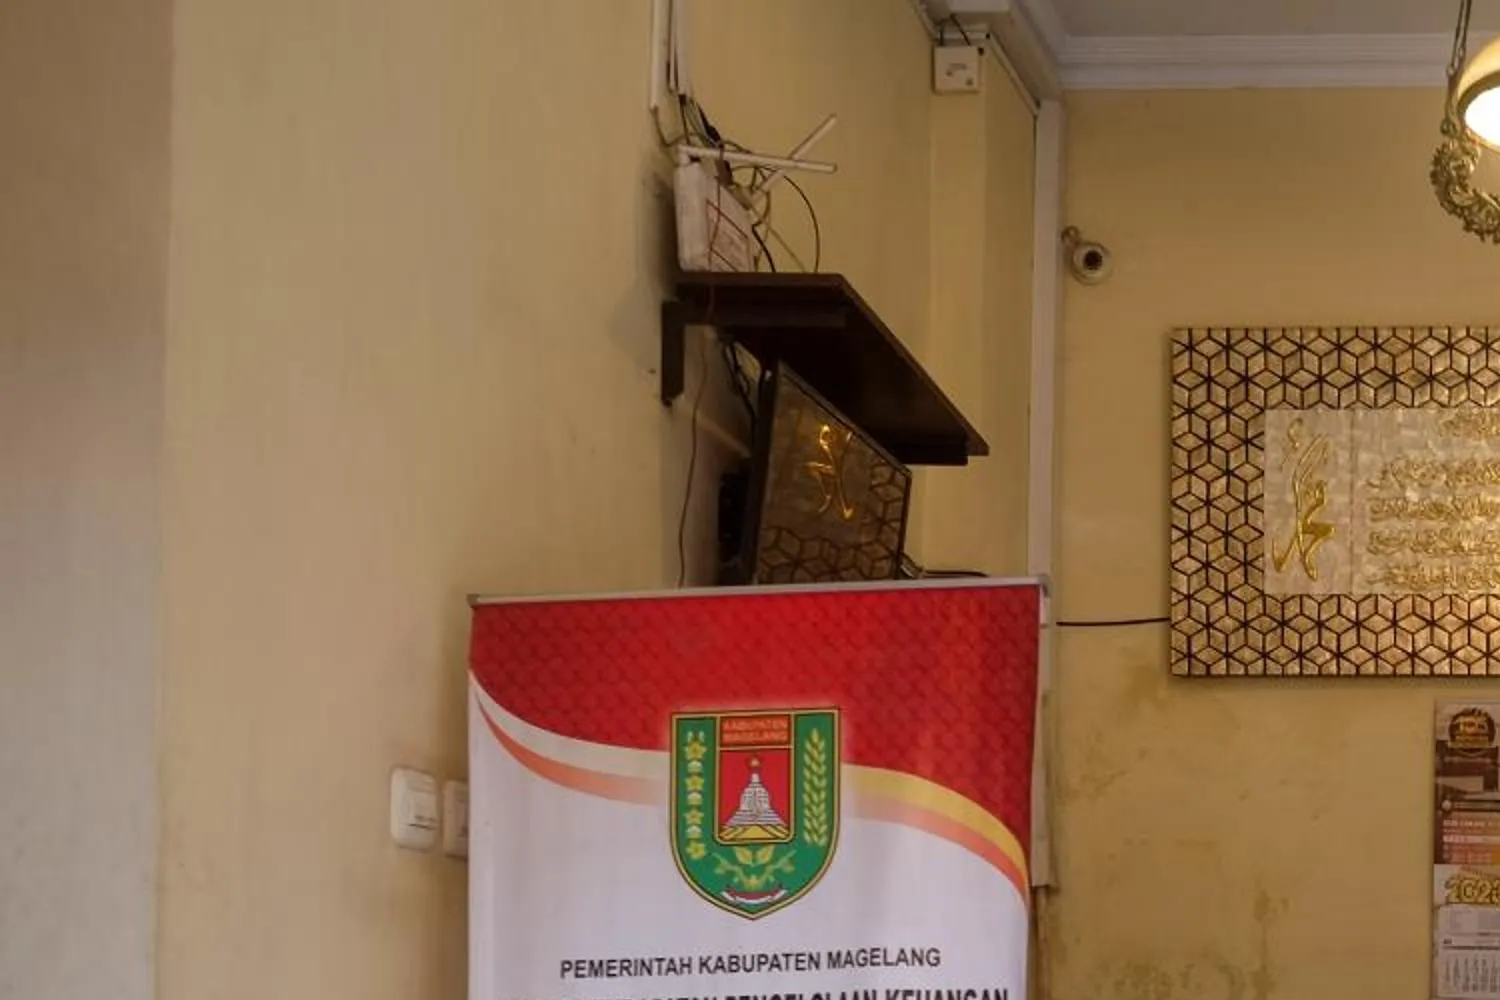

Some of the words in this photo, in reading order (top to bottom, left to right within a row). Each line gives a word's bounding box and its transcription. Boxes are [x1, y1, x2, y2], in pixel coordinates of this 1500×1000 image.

[560, 957, 692, 979] PEMERINTAH
[699, 952, 821, 974] KABUPATEN
[827, 947, 941, 969] MAGELANG
